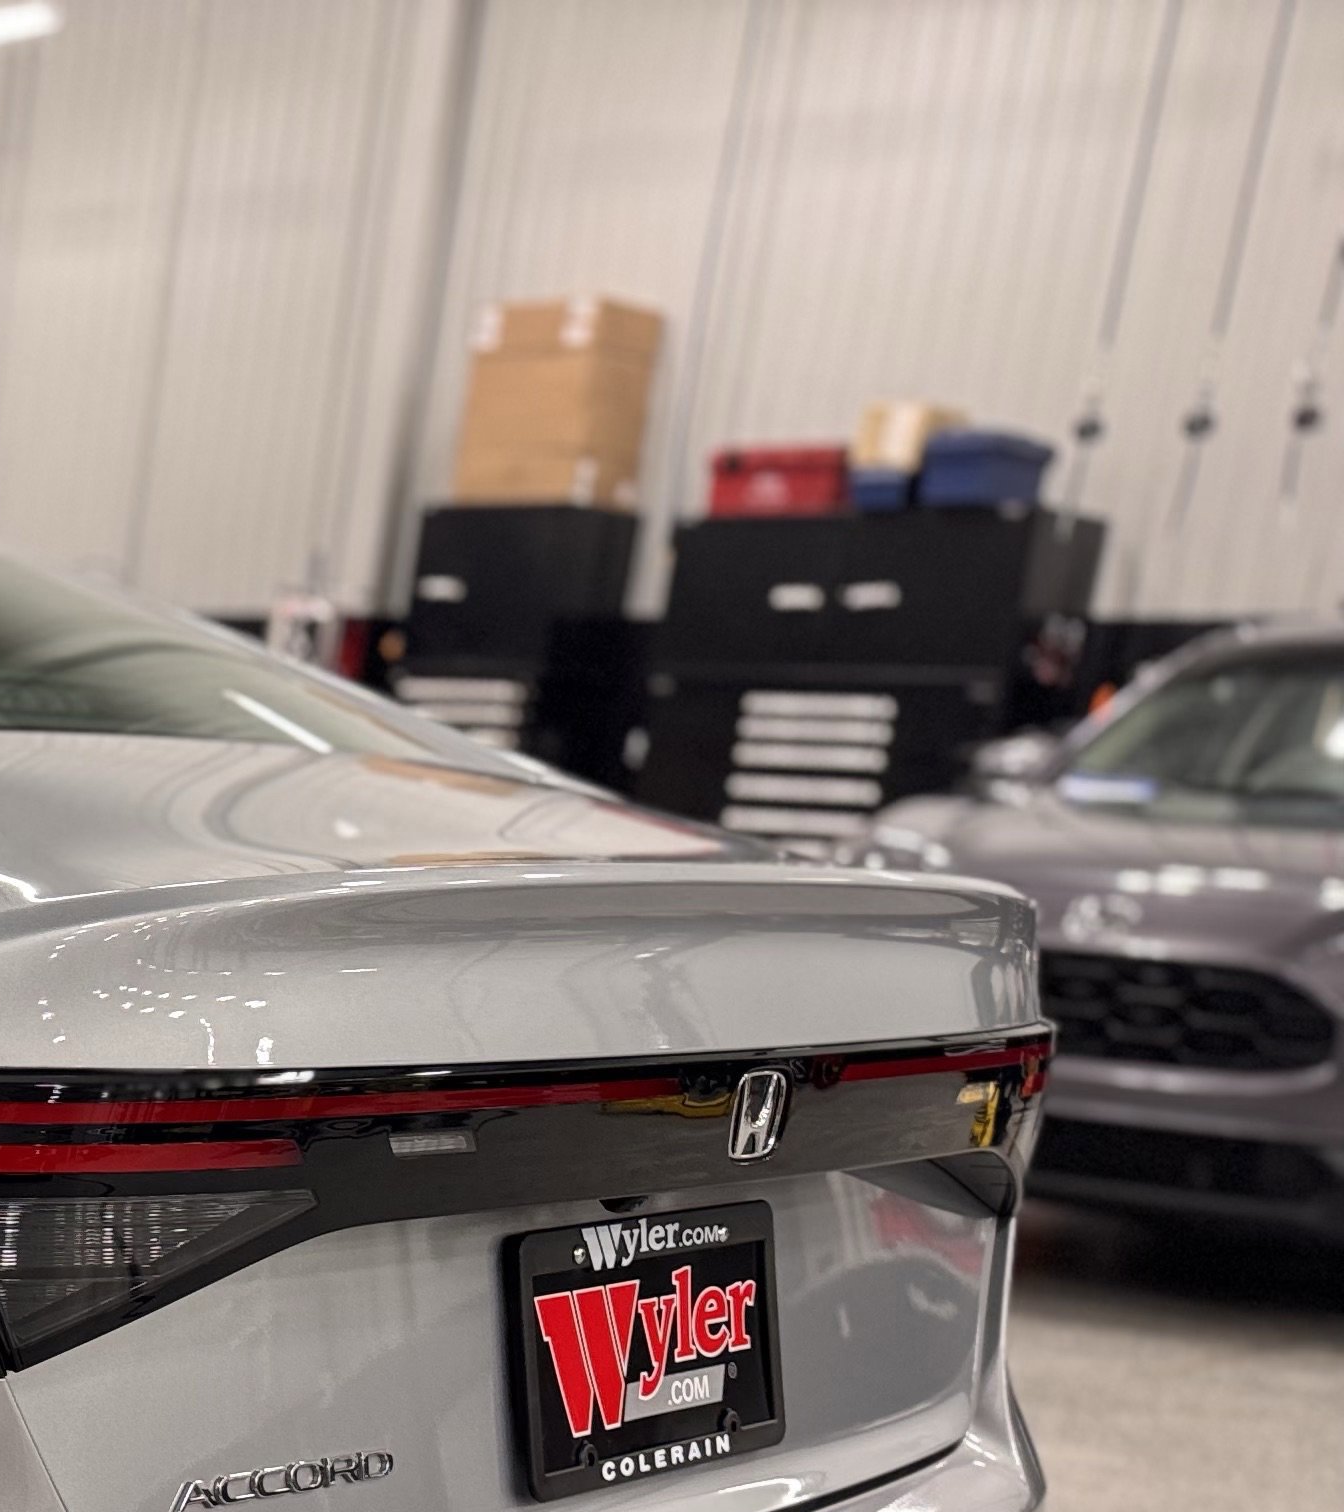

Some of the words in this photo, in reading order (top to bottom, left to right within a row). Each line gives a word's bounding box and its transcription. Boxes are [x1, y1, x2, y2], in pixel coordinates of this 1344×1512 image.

[534, 1265, 756, 1438] Wyler
[668, 1374, 710, 1406] .COM
[601, 1433, 731, 1482] COLERAIN
